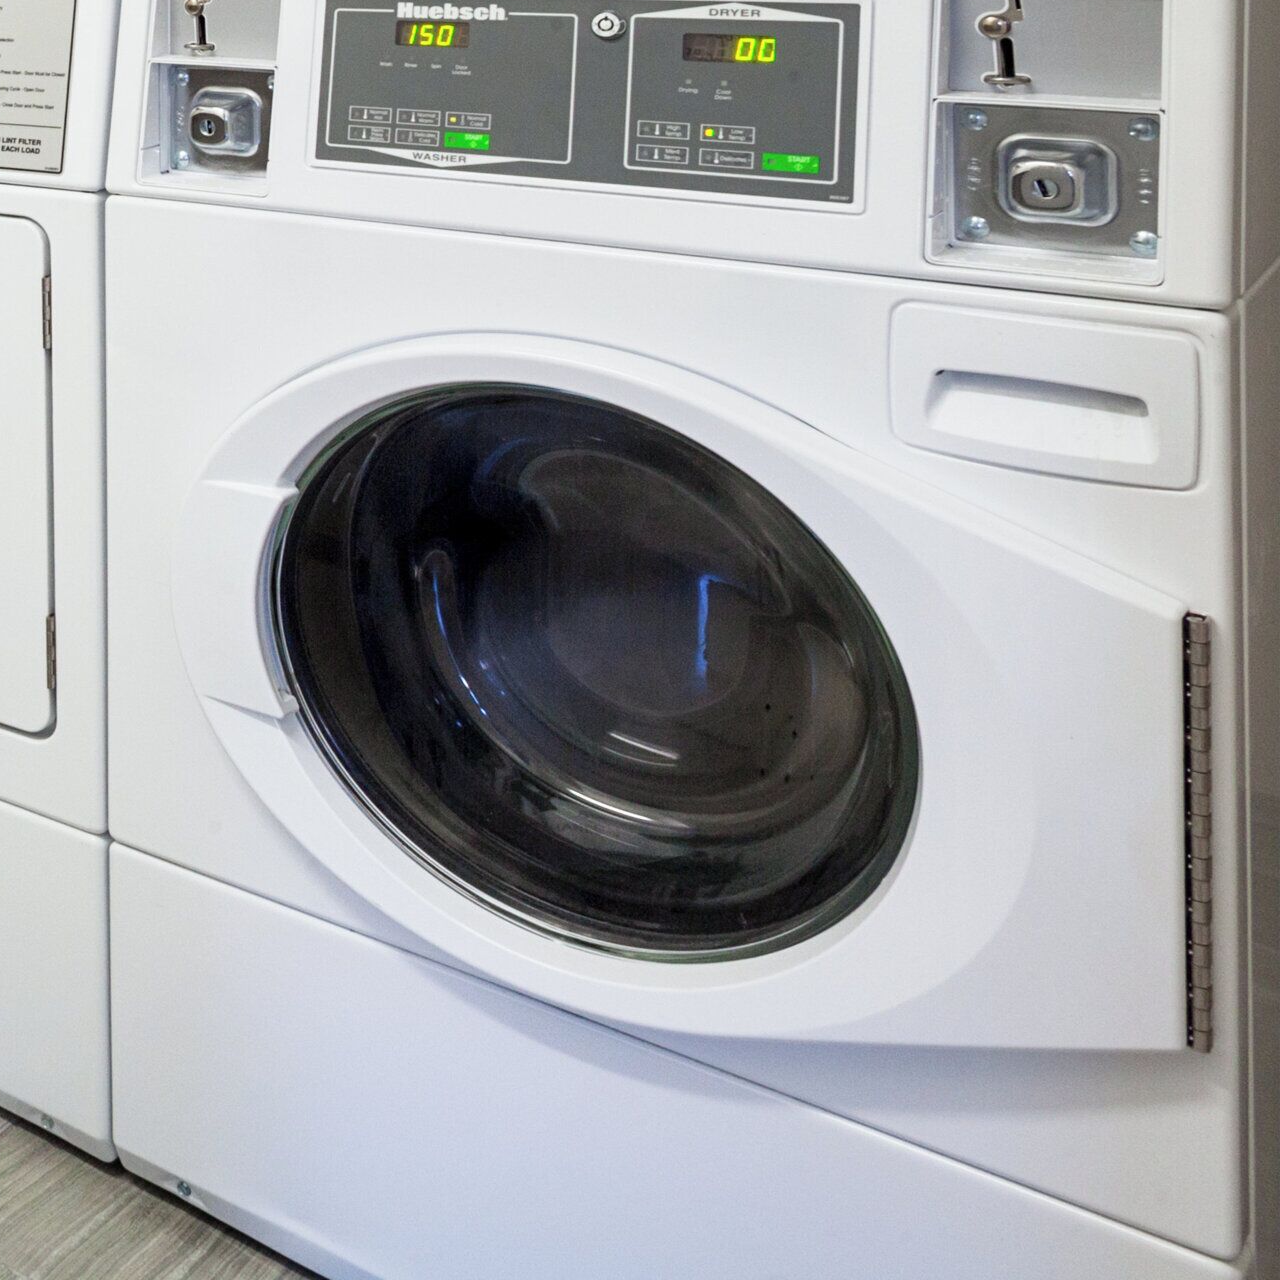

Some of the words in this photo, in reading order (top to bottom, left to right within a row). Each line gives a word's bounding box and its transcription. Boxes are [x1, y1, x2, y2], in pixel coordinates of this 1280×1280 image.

[397, 2, 506, 20] Huebsch
[709, 9, 761, 17] DRYER
[409, 24, 454, 46] 150
[735, 37, 776, 62] 00
[413, 152, 466, 163] WASHER
